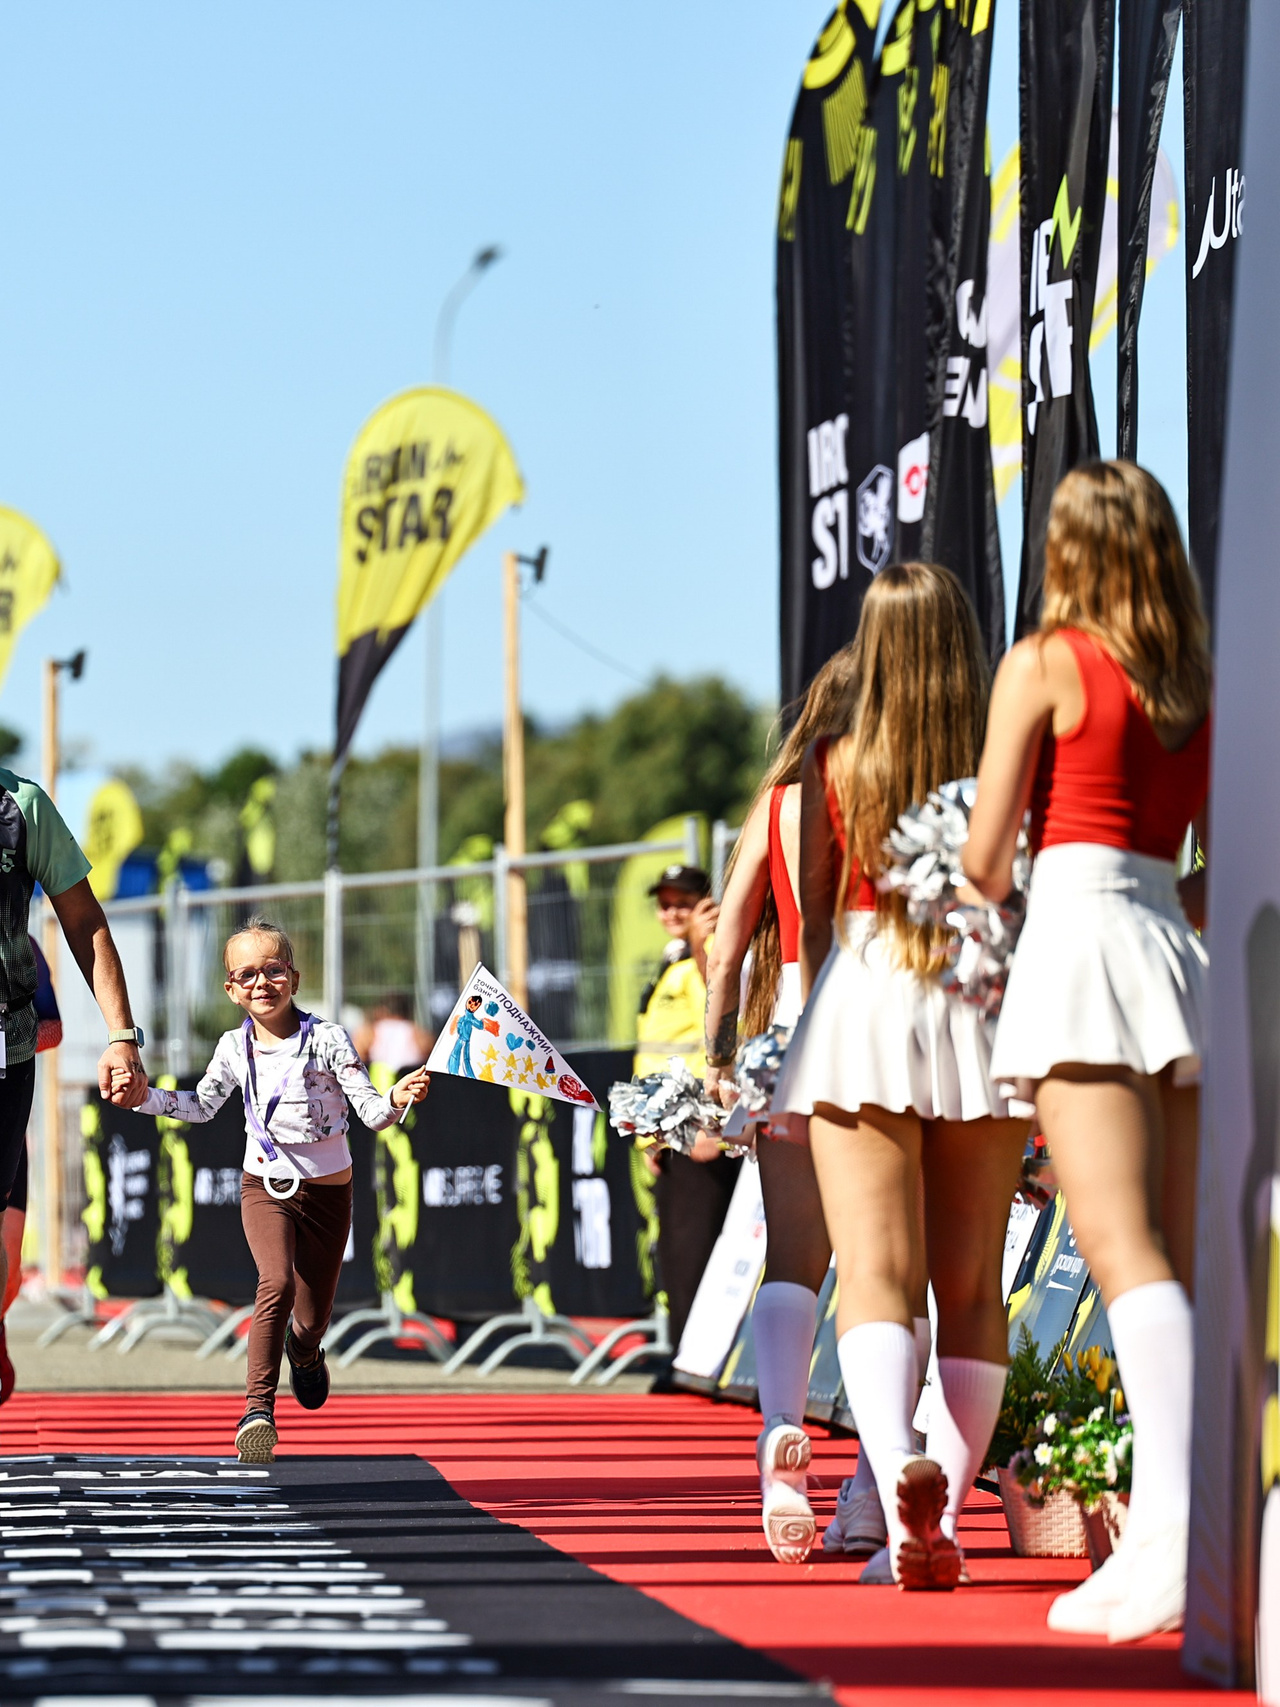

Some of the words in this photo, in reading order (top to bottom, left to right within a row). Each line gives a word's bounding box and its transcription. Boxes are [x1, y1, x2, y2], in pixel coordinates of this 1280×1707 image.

[355, 485, 453, 565] STAR
[473, 984, 493, 998] банк
[477, 979, 499, 994] точка
[496, 993, 554, 1056] ПОДНАЖМИ!
